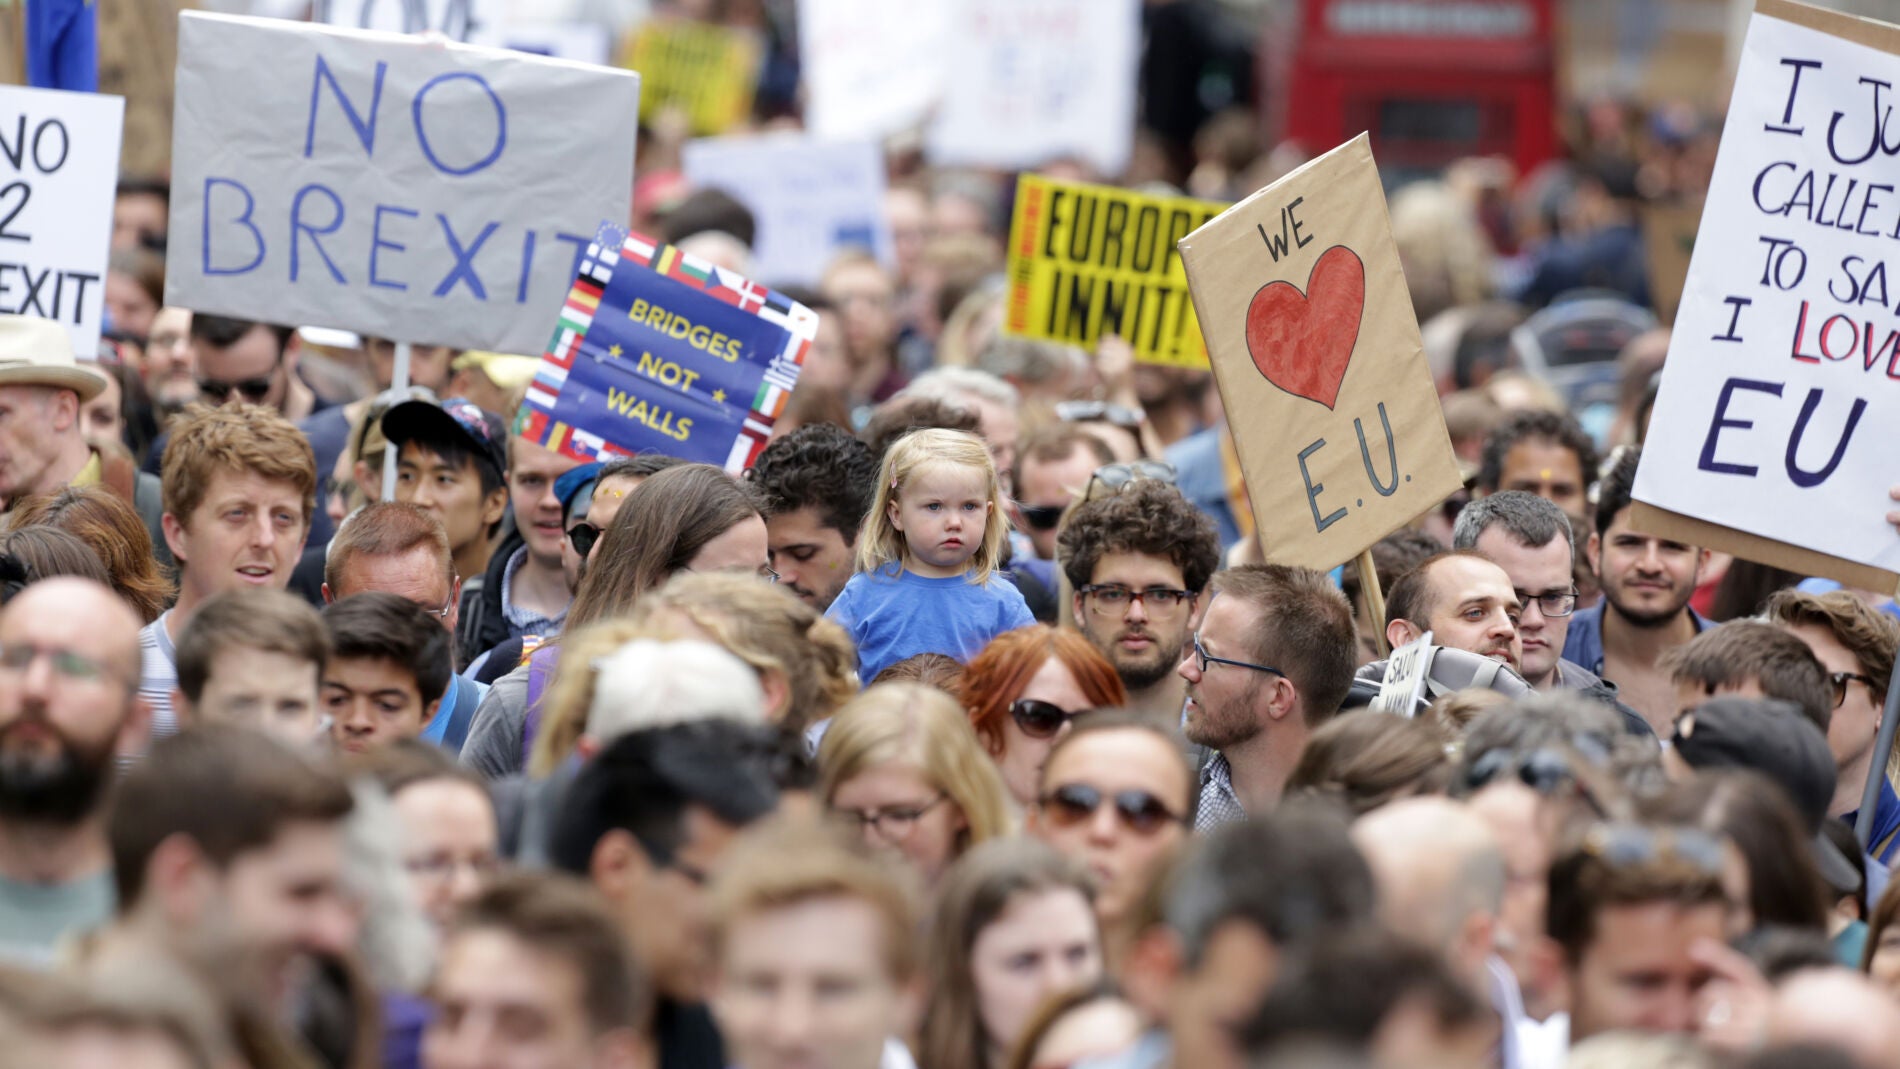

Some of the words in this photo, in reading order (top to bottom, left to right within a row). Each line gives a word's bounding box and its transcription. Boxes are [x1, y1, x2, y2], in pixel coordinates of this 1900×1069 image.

[305, 54, 507, 177] NO
[1764, 58, 1822, 136] I
[0, 115, 69, 175] NO
[0, 181, 31, 242] 2
[203, 178, 591, 304] BREXIT
[1046, 191, 1216, 275] EUROP
[1257, 196, 1314, 262] WE
[1047, 270, 1189, 354] INNIT!
[1759, 236, 1807, 291] TO
[1828, 255, 1900, 316] SA
[628, 298, 743, 363] BRIDGES
[1711, 295, 1752, 343] I
[637, 352, 699, 392] NOT
[606, 387, 693, 441] WALLS
[1697, 377, 1868, 488] EU
[1297, 401, 1411, 532] E.U.
